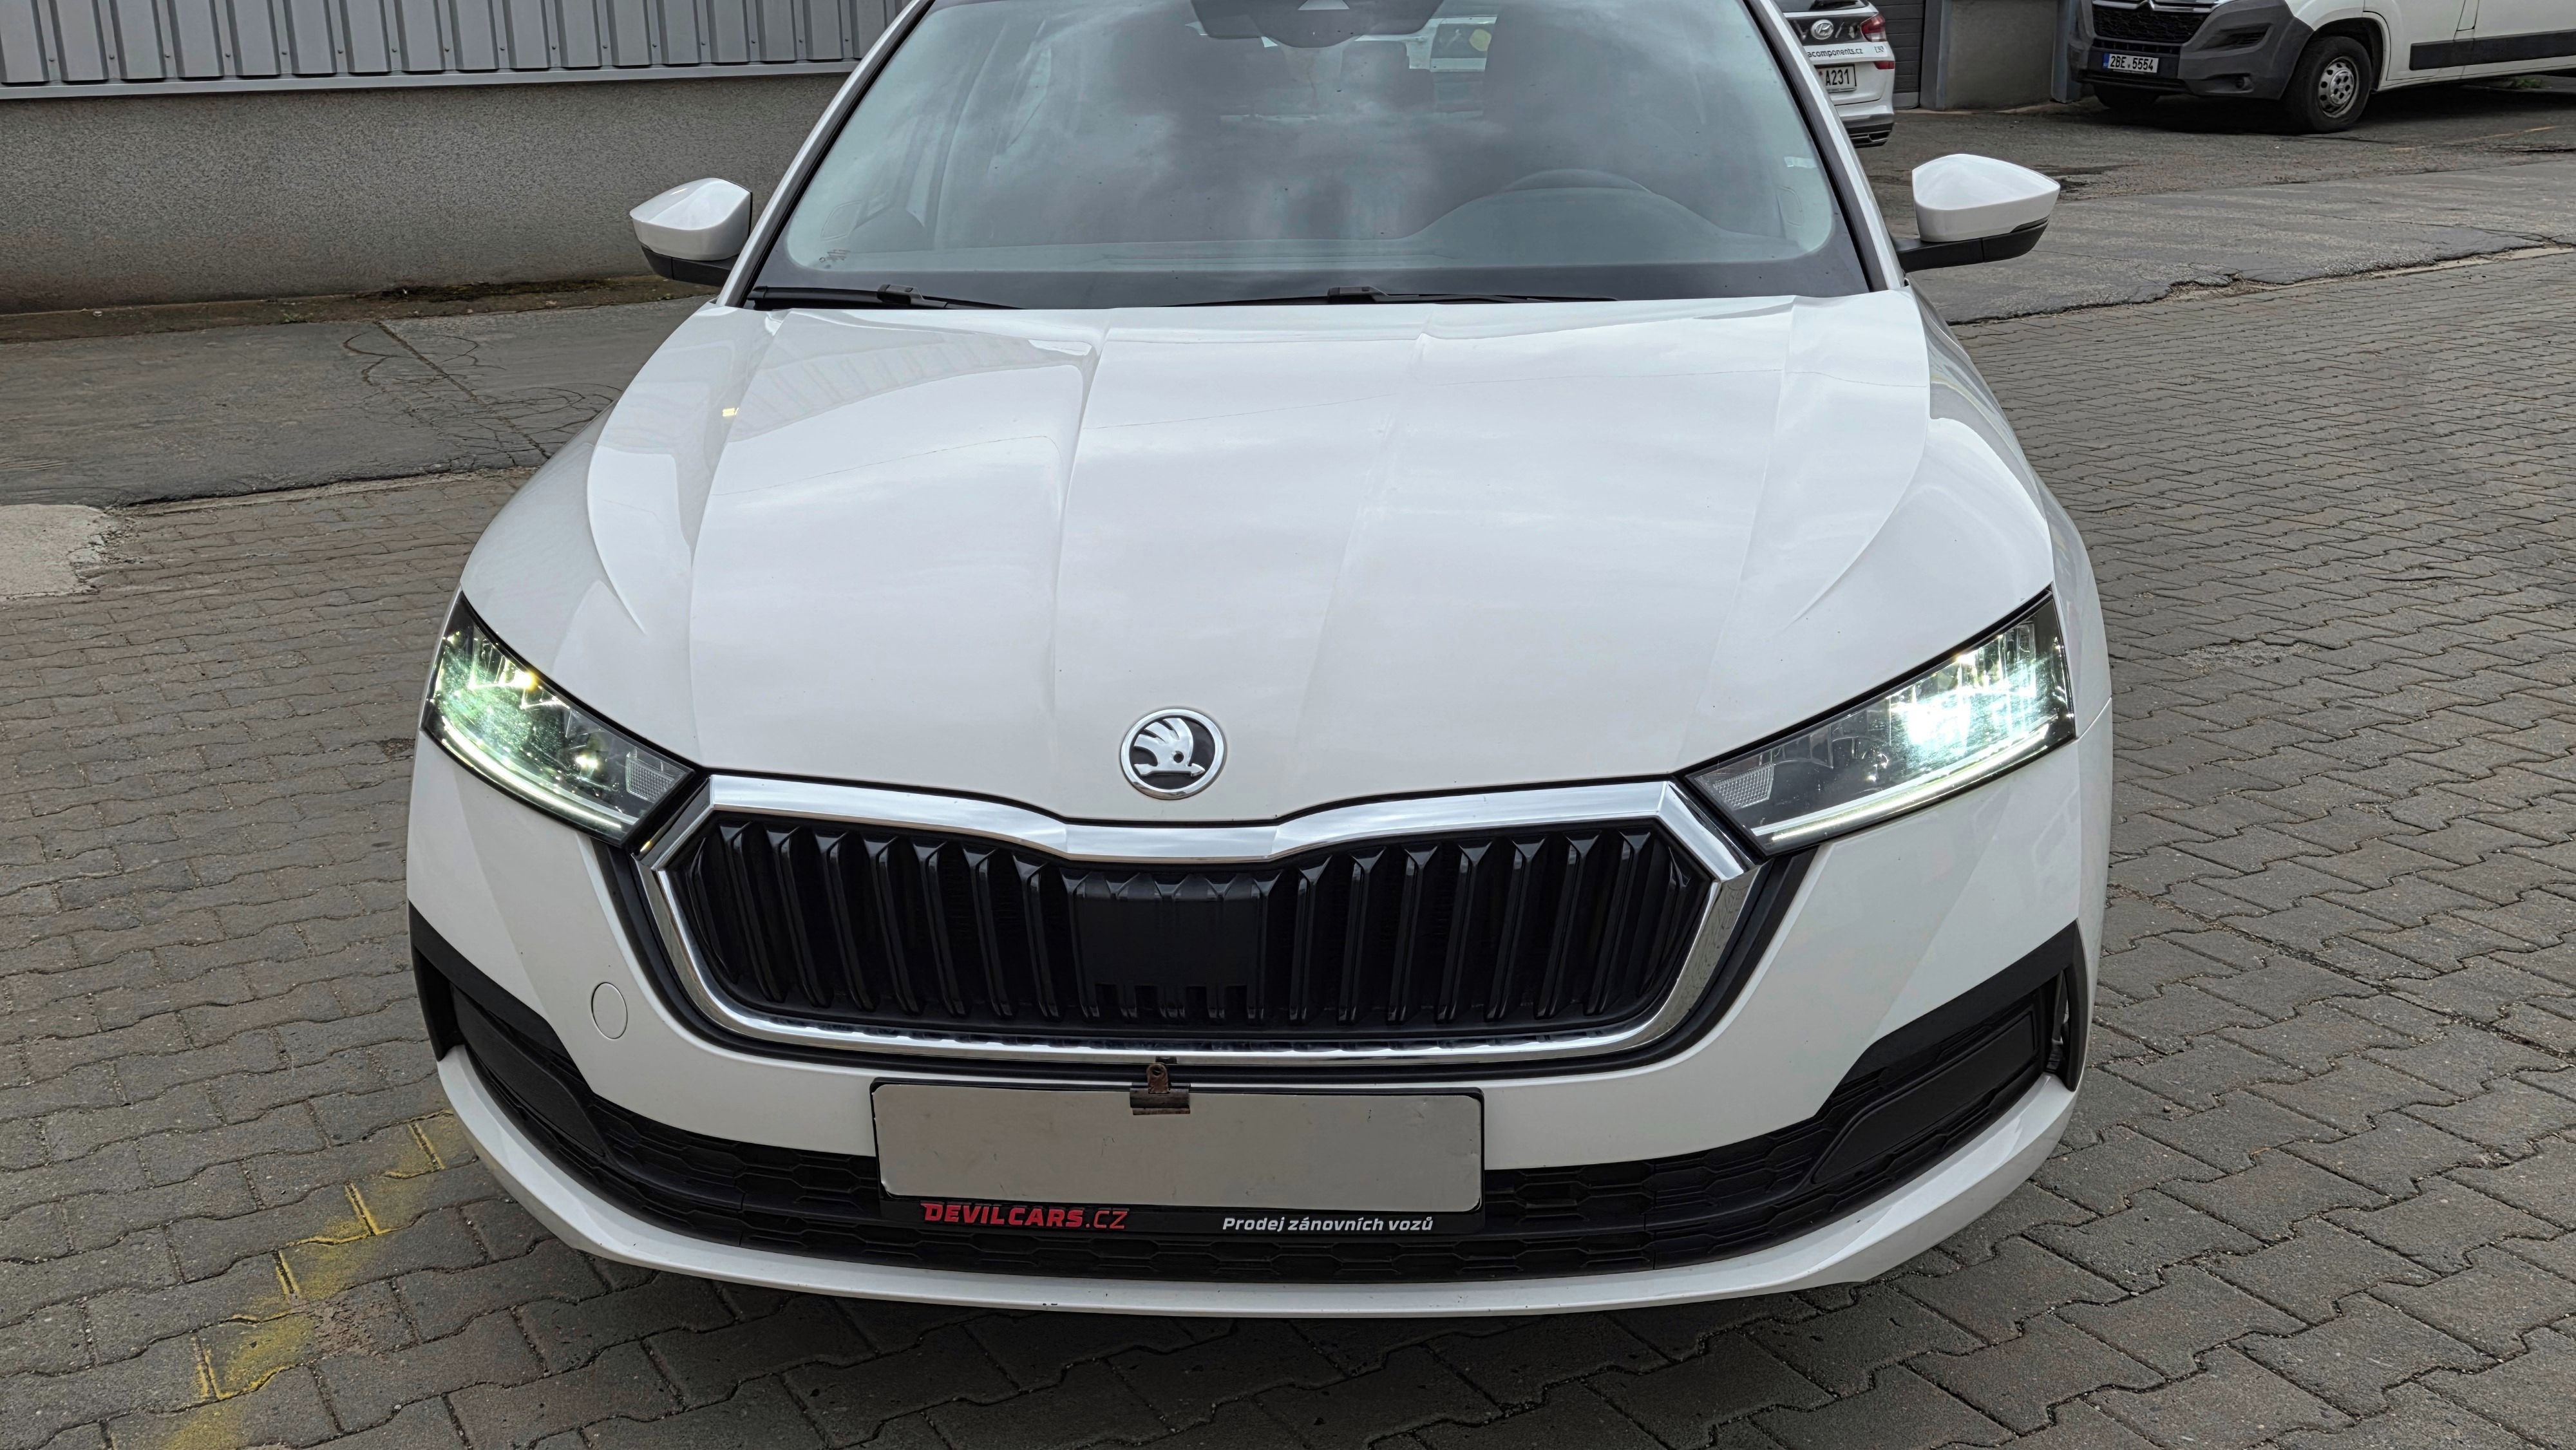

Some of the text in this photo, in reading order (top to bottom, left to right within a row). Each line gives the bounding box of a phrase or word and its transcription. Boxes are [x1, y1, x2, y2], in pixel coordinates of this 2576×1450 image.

[921, 1203, 1128, 1229] DEVILCARS.CZ
[1222, 1216, 1433, 1232] Prodej zánovních vozů
